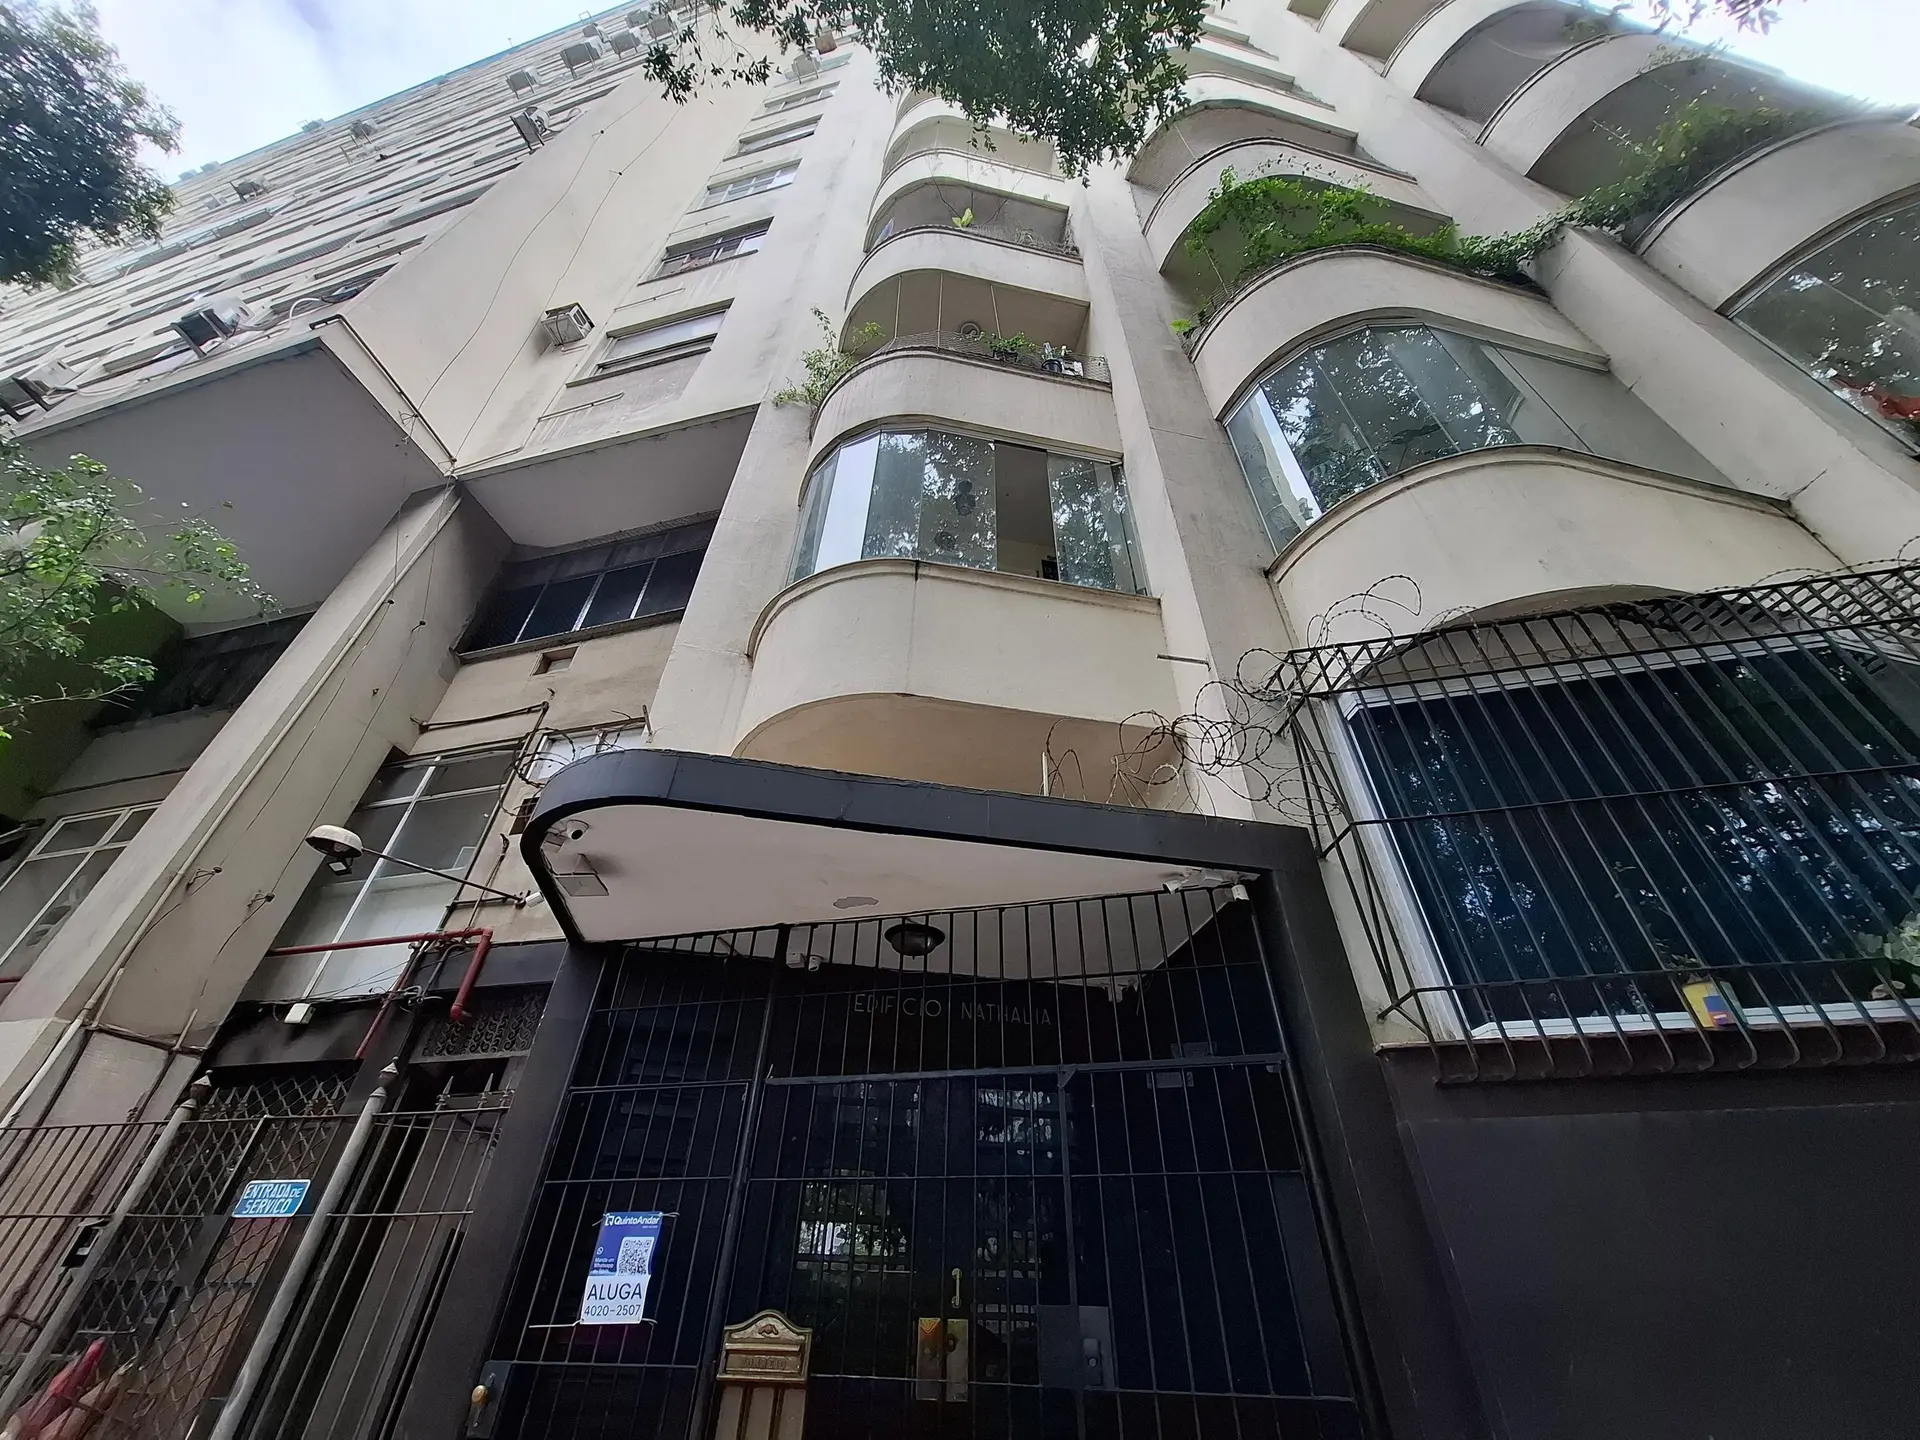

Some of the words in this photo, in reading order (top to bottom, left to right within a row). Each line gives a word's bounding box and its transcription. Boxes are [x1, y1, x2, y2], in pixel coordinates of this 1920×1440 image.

[854, 993, 942, 1017] EDIFCIO
[961, 1001, 1052, 1026] NATHALIA
[244, 1184, 291, 1199] ENTRADA
[290, 1187, 303, 1198] DE
[614, 1216, 660, 1225] QuintoAndar
[587, 1283, 642, 1300] ALUGA
[584, 1304, 641, 1317] 4020-2507
